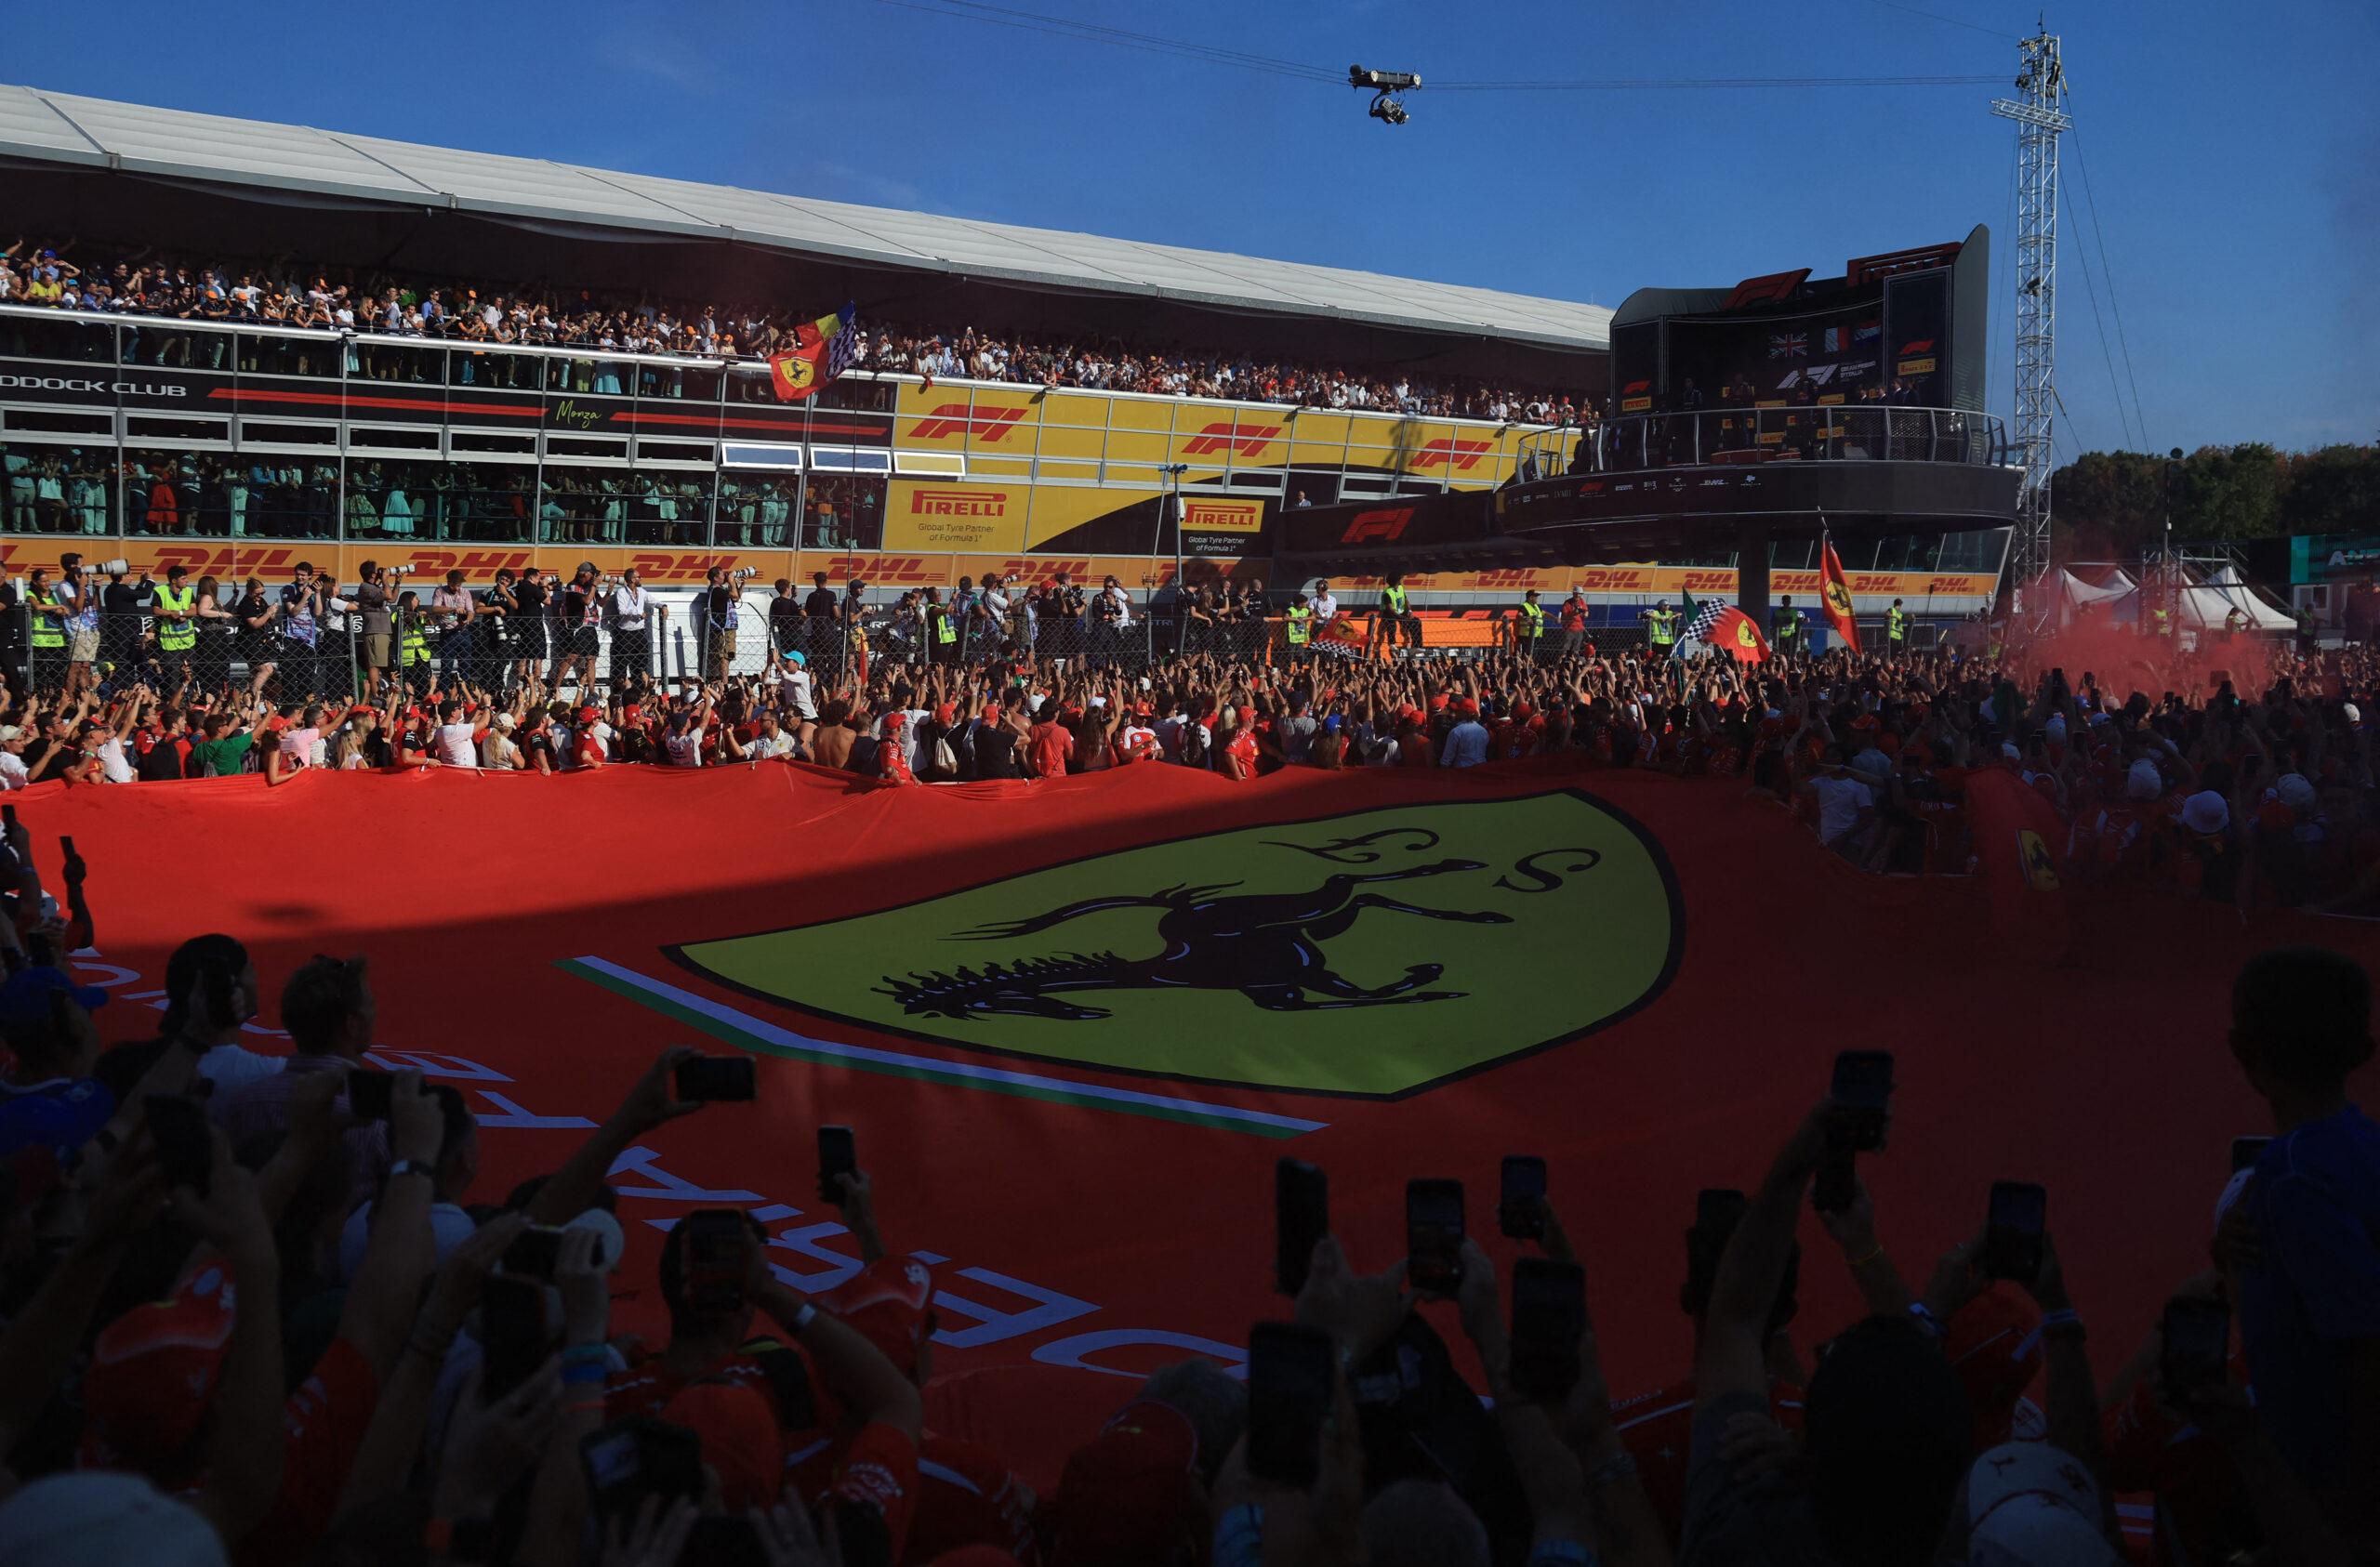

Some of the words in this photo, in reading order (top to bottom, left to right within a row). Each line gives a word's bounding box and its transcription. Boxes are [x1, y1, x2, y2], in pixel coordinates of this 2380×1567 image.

[112, 382, 187, 397] CLUB
[555, 400, 602, 429] Monza
[907, 403, 1028, 442] F1
[1181, 423, 1282, 457] F1
[1408, 439, 1493, 469] F1
[911, 490, 1007, 517] PIRELLI
[1185, 504, 1257, 526] PIRELLI
[1341, 507, 1416, 543] F1
[919, 522, 944, 532] Global
[946, 523, 964, 533] Tyre
[965, 524, 995, 533] Partner
[929, 533, 938, 541] of
[940, 533, 972, 542] Formula
[1188, 535, 1209, 544] Global
[1209, 536, 1223, 546] Tyre
[1223, 536, 1246, 545] Partner
[152, 547, 297, 576] DHL
[405, 551, 531, 578] DHL
[826, 557, 928, 581] DHL
[1002, 560, 1090, 583] DHL
[1476, 569, 1537, 587] DHL
[1583, 571, 1640, 588] DHL
[1683, 573, 1734, 589] DHL
[1771, 574, 1820, 591] DHL
[1853, 576, 1897, 591] DHL
[1931, 577, 1970, 592] DHL
[1492, 848, 1601, 892] S
